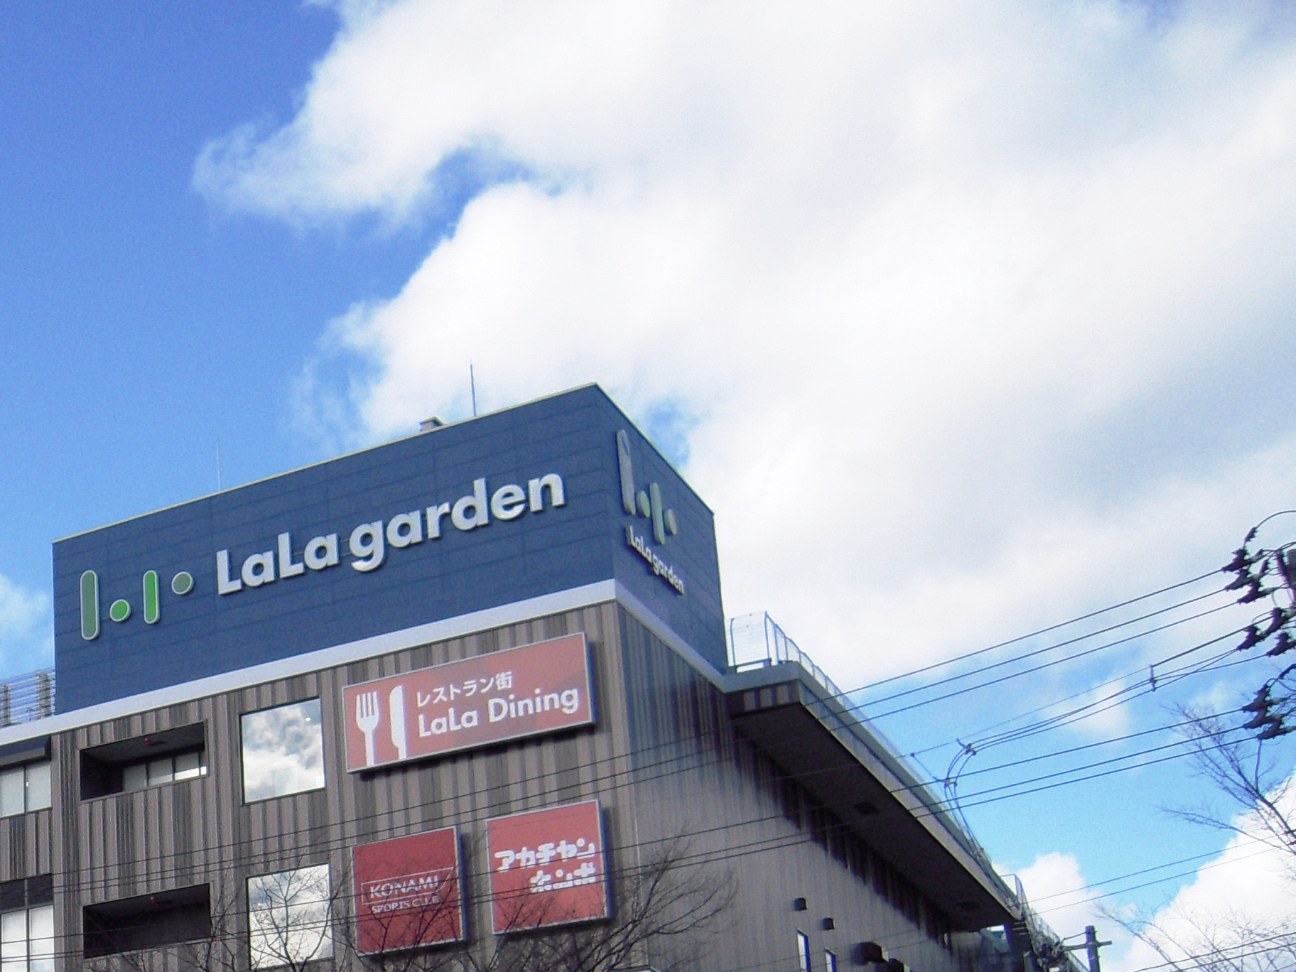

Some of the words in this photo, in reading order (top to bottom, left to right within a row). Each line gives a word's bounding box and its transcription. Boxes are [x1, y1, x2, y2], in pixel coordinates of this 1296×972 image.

[217, 531, 339, 595] LaLa
[349, 472, 566, 573] garden
[416, 671, 512, 708] レストラン街
[418, 707, 479, 738] LaLa
[488, 687, 579, 723] Dining
[370, 875, 439, 898] KONAMI
